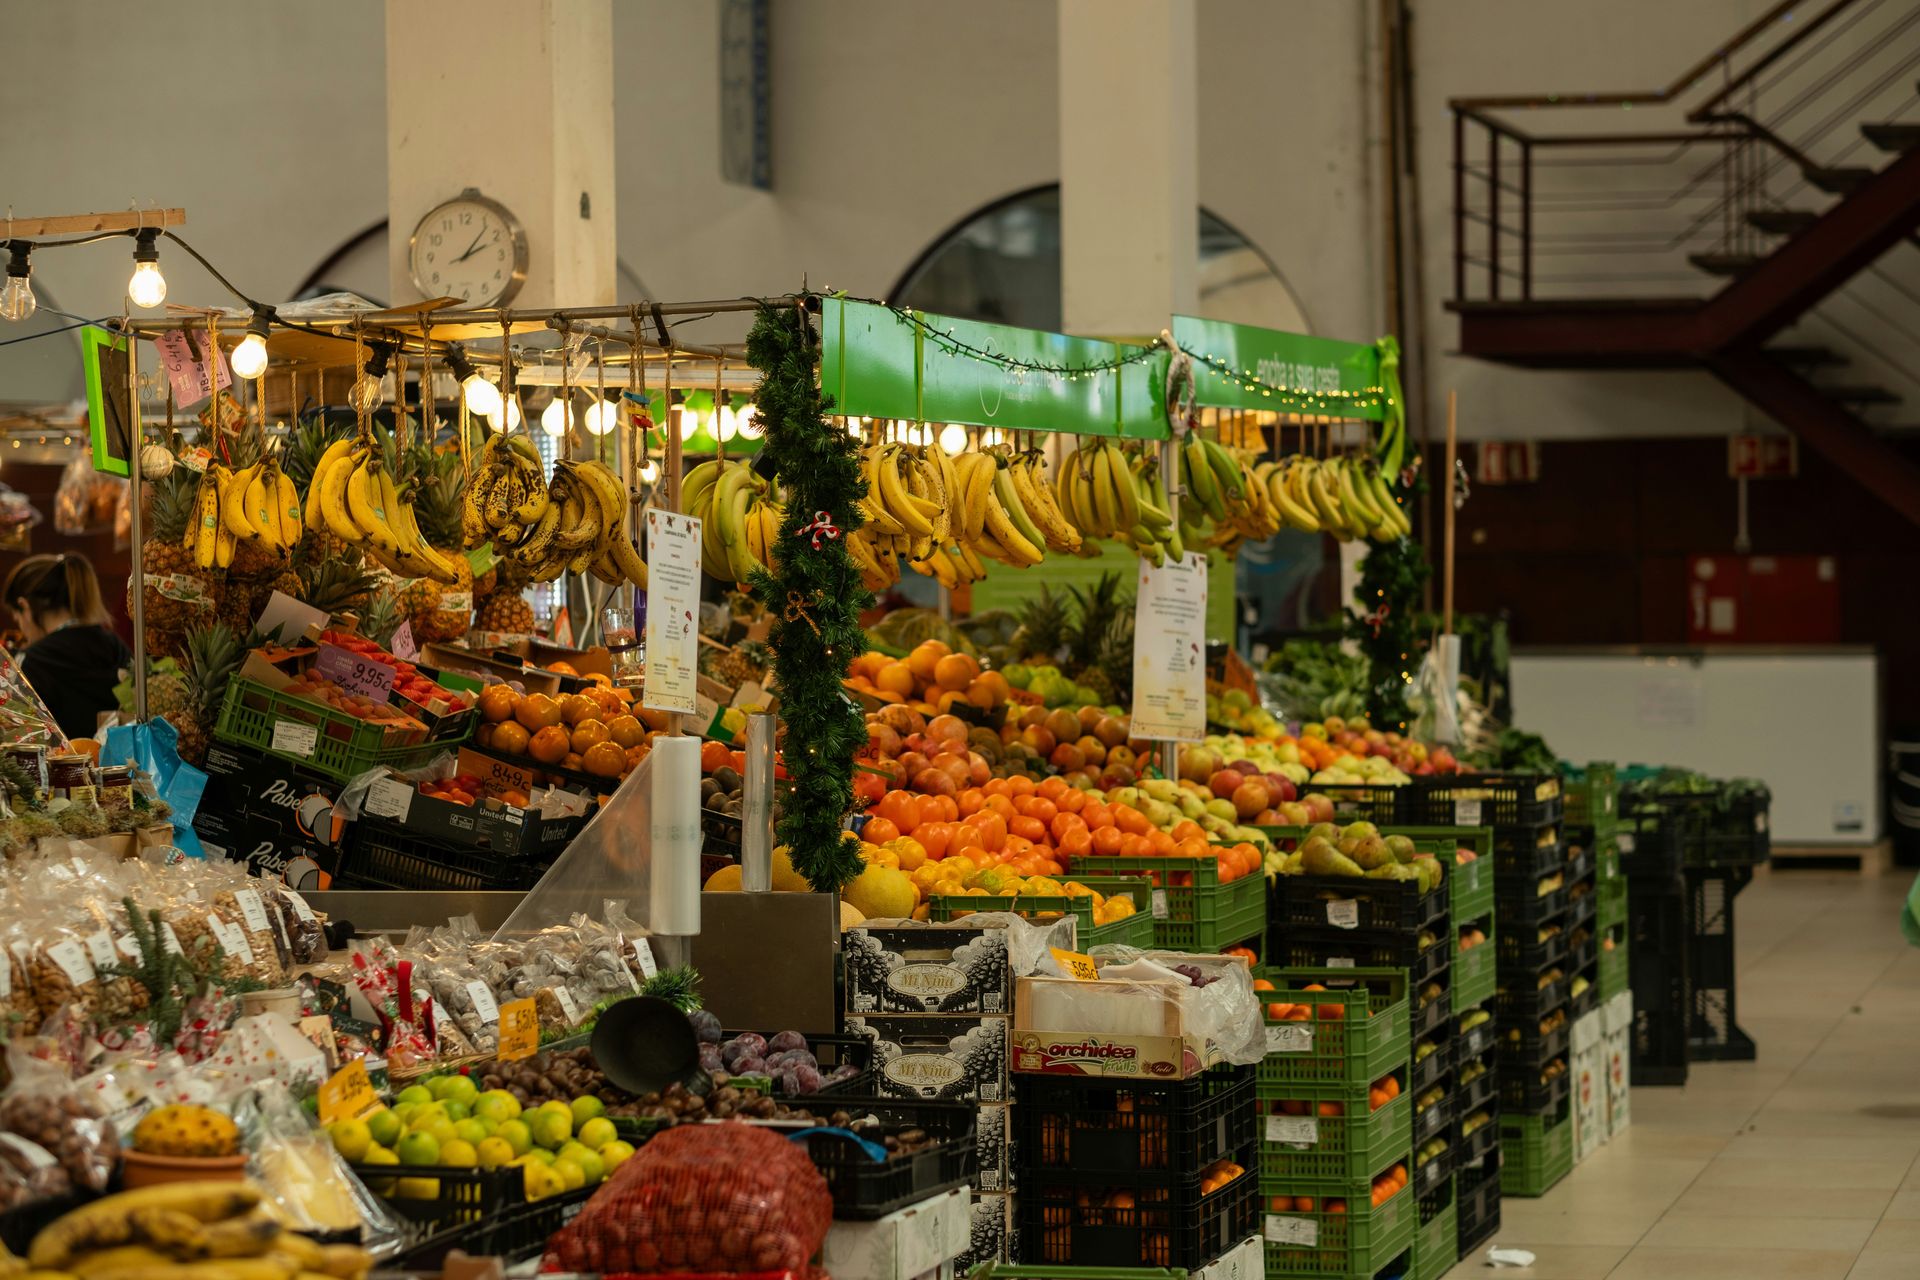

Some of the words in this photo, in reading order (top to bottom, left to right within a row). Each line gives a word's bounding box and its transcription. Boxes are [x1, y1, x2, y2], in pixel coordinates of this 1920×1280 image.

[459, 212, 472, 225] 12
[442, 219, 453, 232] 11
[429, 234, 443, 246] 10
[492, 230, 500, 242] 2
[427, 252, 435, 263] 9
[498, 249, 505, 261] 3
[432, 272, 440, 284] 8
[494, 270, 501, 280] 4
[446, 284, 452, 295] 7
[462, 288, 470, 299] 6
[481, 283, 489, 294] 5
[352, 663, 392, 692] 9,95€
[480, 807, 506, 821] United
[542, 822, 569, 842] United
[900, 974, 918, 987] Mi
[921, 973, 954, 987] Niña
[1048, 1039, 1137, 1059] orchidea
[898, 1063, 916, 1077] Mi
[919, 1063, 951, 1077] Niña
